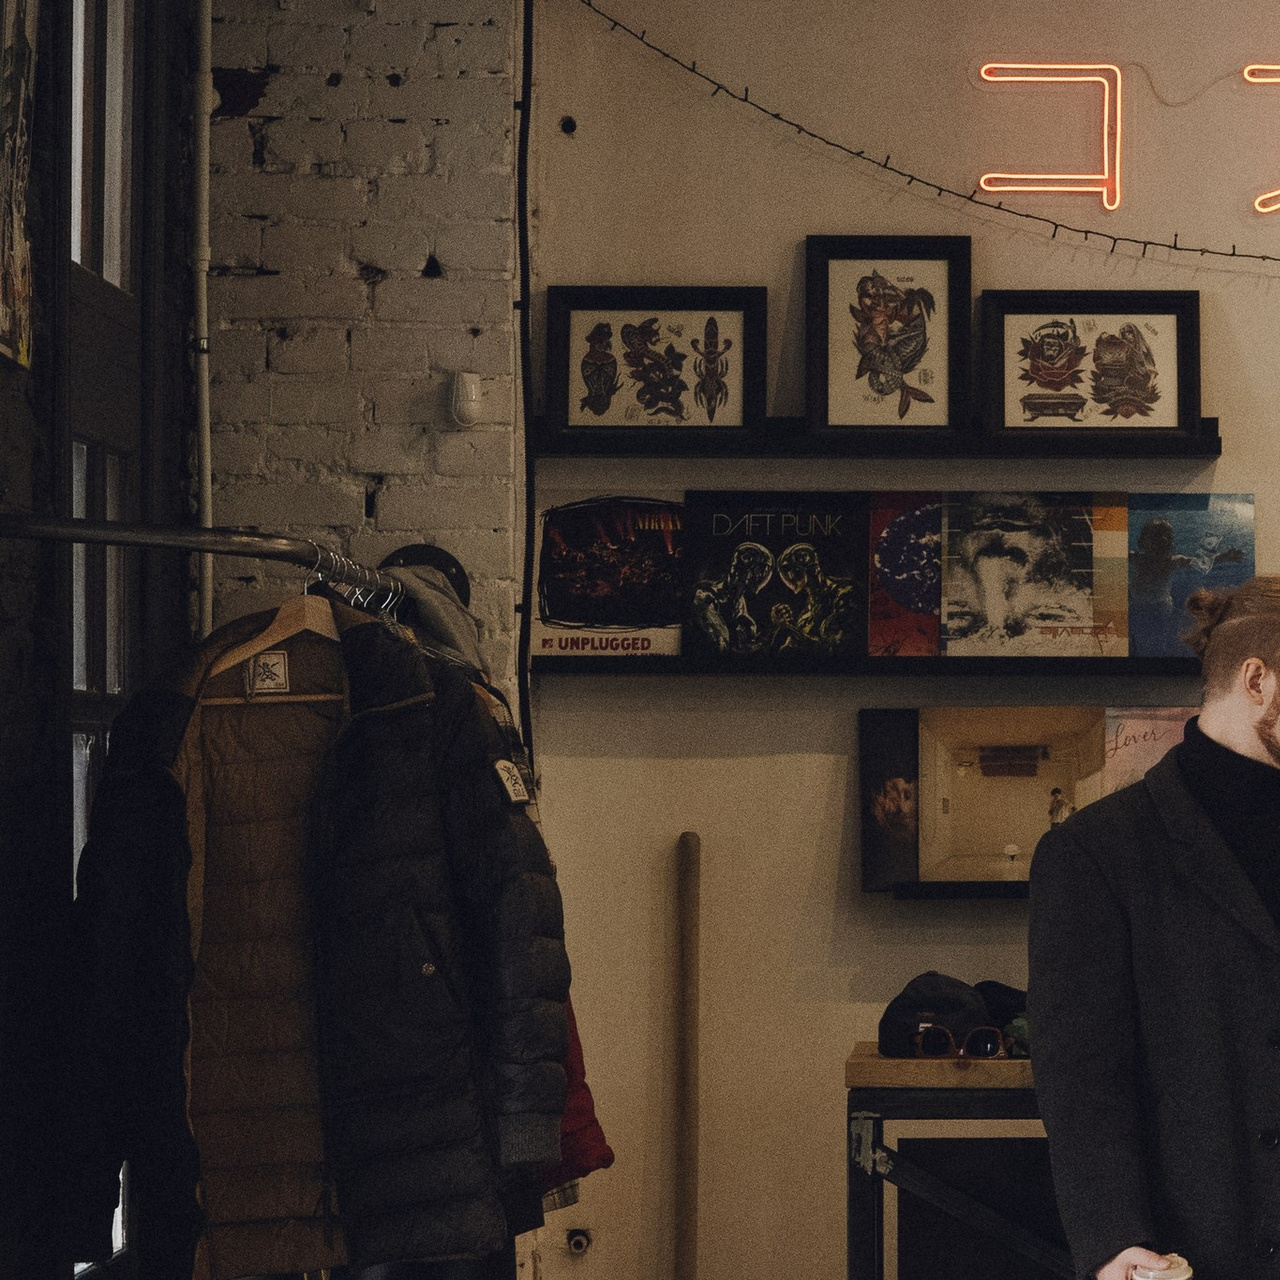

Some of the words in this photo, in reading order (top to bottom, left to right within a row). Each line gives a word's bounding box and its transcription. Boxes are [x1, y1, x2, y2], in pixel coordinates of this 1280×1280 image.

[712, 513, 776, 536] DAFT
[782, 513, 843, 536] PUNK
[558, 637, 652, 651] UNPLUGGED
[1105, 722, 1171, 759] Lover
